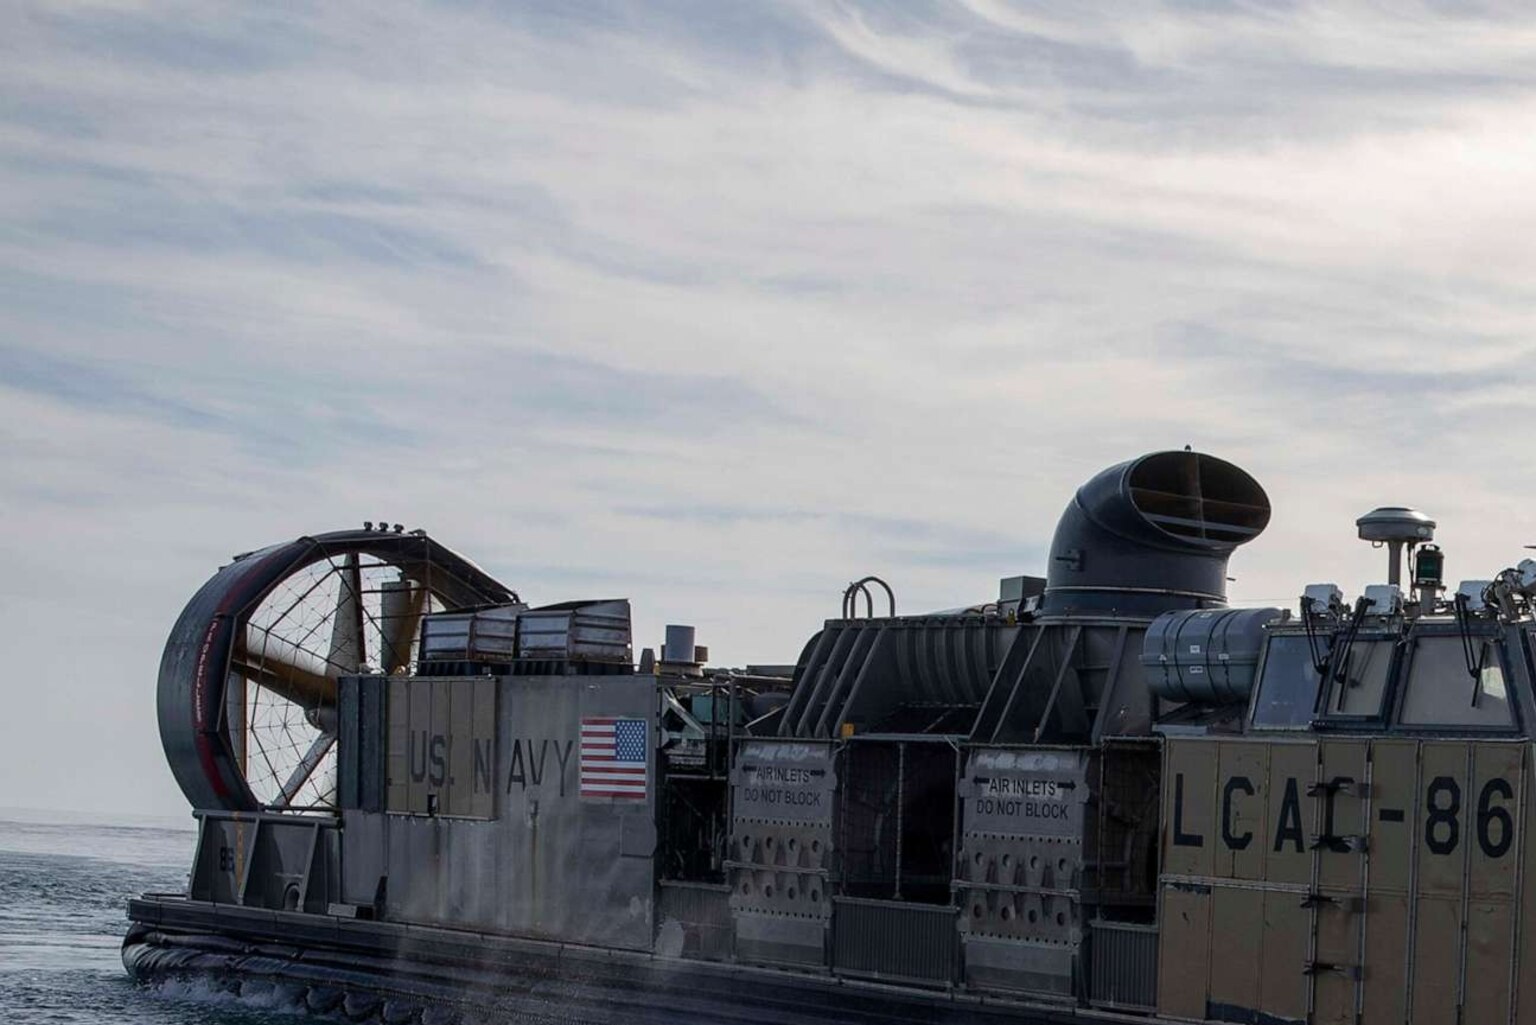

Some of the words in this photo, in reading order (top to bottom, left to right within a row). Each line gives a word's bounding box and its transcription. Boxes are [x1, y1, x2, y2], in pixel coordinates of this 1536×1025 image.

[473, 739, 574, 797] NAVY
[757, 765, 773, 780] AIR
[774, 766, 809, 783] INLETS
[989, 777, 1010, 793] AIR
[1013, 779, 1056, 796] INLETS
[744, 788, 759, 802] DO
[761, 788, 783, 804] NOT
[784, 790, 821, 807] BLOCK
[977, 799, 994, 815] DO
[997, 799, 1022, 816] NOT
[1025, 802, 1069, 820] BLOCK
[1173, 773, 1515, 859] LCAC-86
